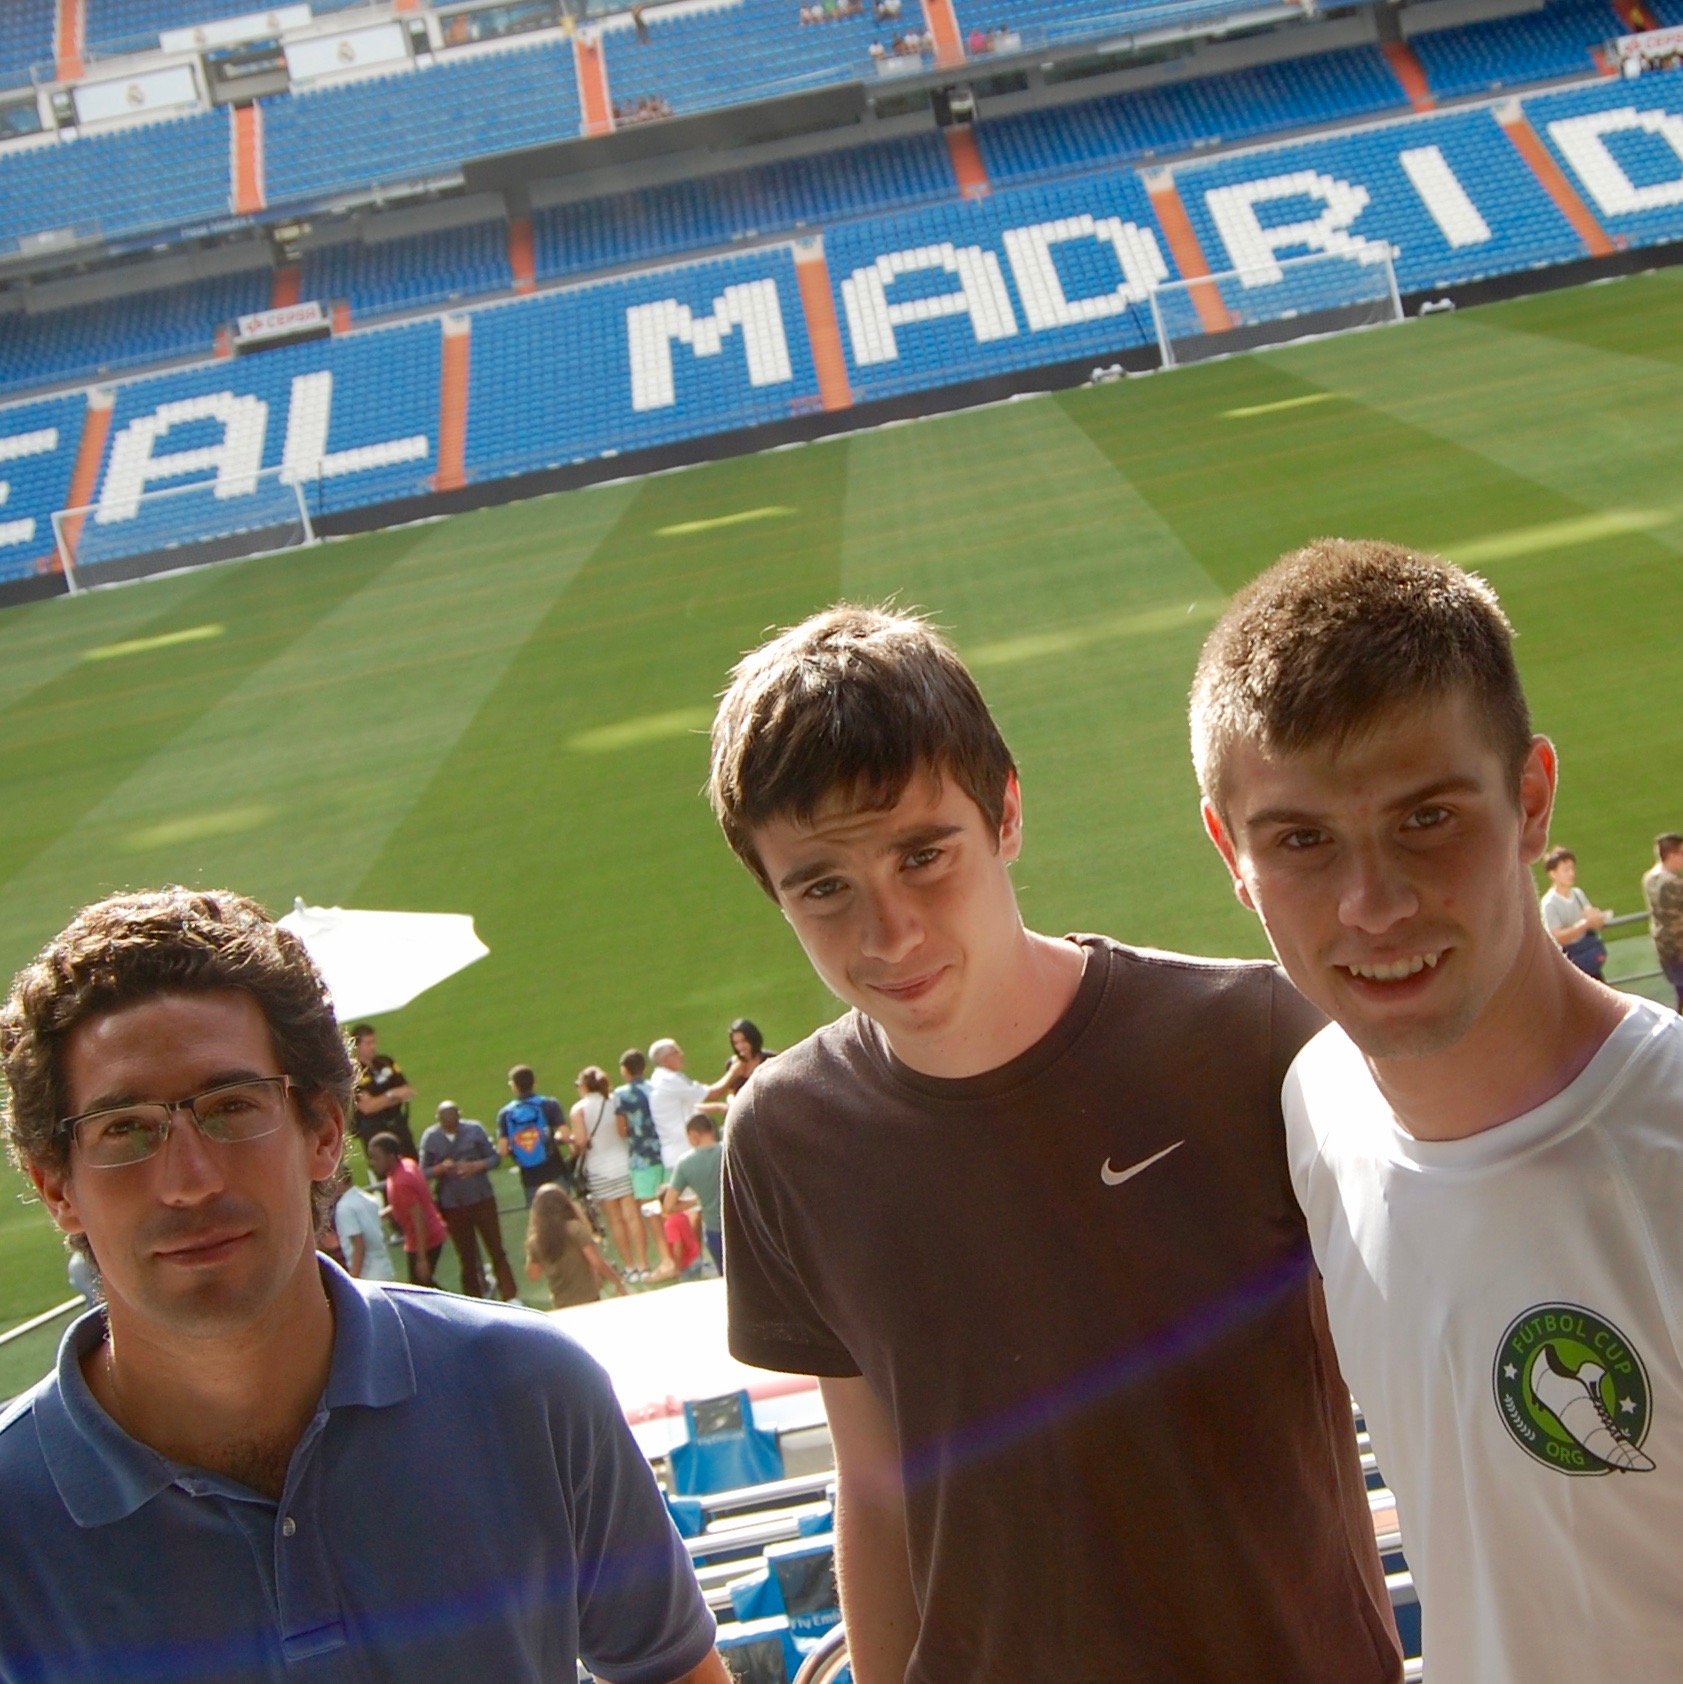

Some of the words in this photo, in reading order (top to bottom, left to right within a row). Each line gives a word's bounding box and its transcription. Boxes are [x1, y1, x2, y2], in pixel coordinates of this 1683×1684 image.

[626, 107, 1683, 411] MADRID
[267, 307, 317, 328] CEPSA
[1594, 1331, 1632, 1375] CUP
[1546, 1442, 1585, 1466] ORG
